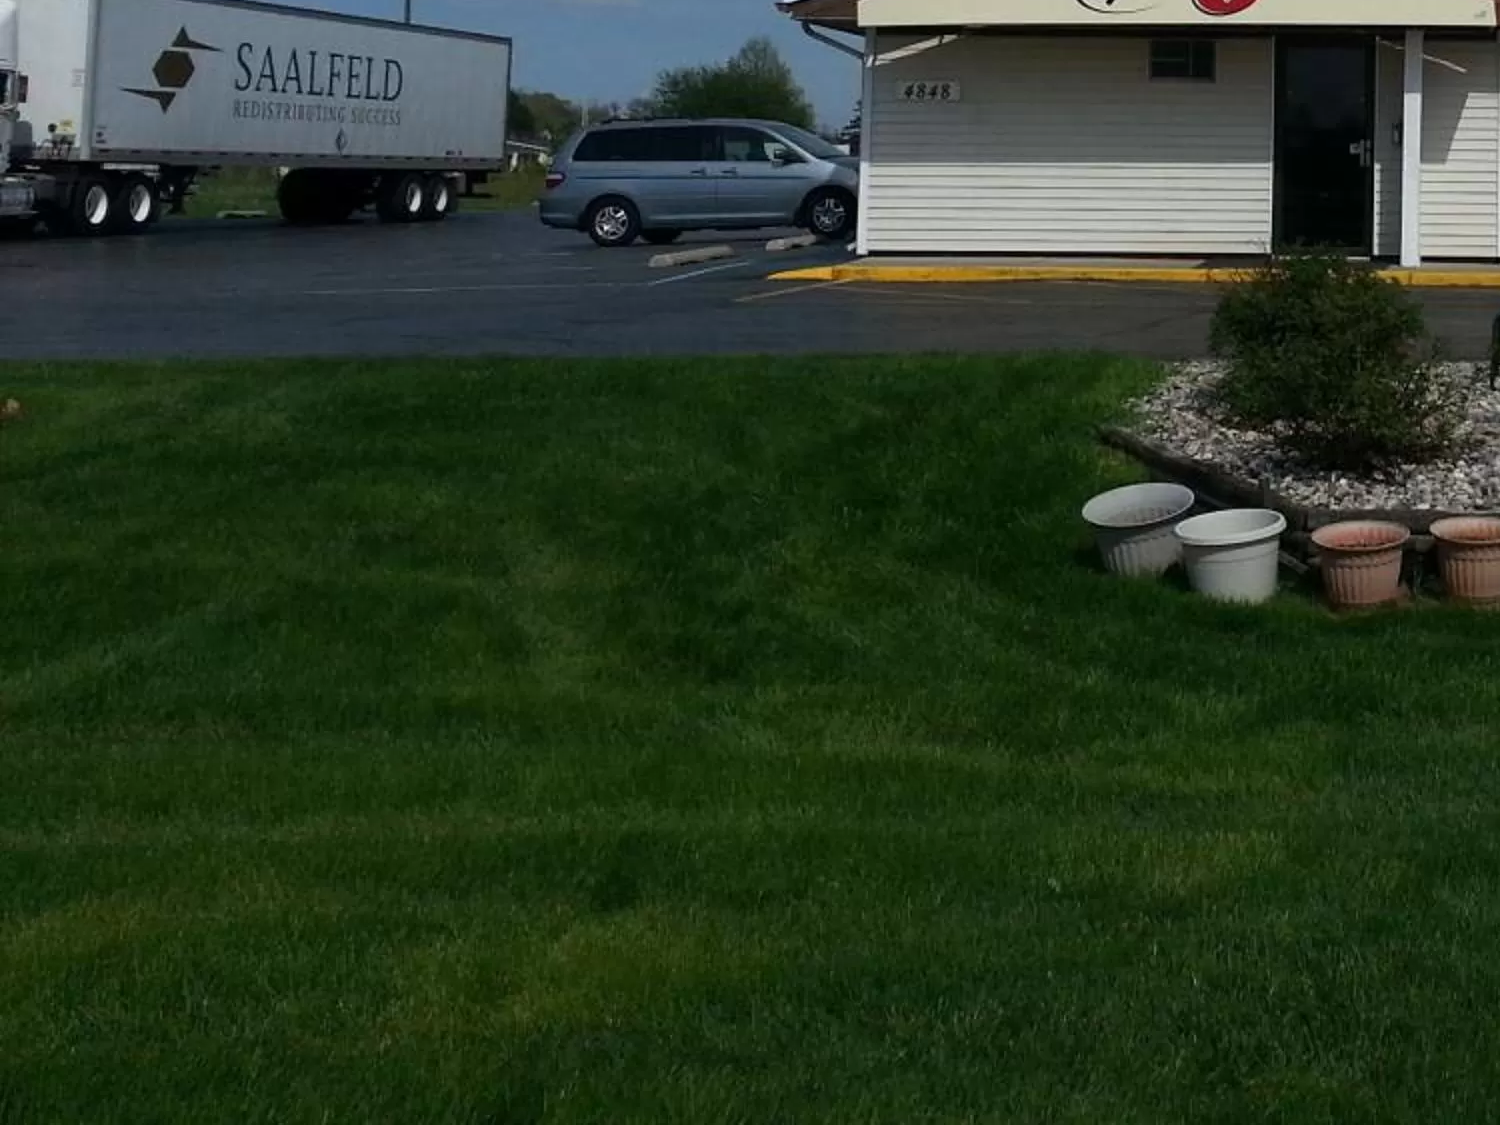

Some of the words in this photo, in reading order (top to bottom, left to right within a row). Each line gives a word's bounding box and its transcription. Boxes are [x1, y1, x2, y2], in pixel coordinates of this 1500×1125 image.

[234, 42, 404, 101] SAALFELD
[903, 82, 951, 100] 4848
[232, 98, 347, 124] REDISTRIBUTING
[350, 106, 402, 126] SUCCESS
